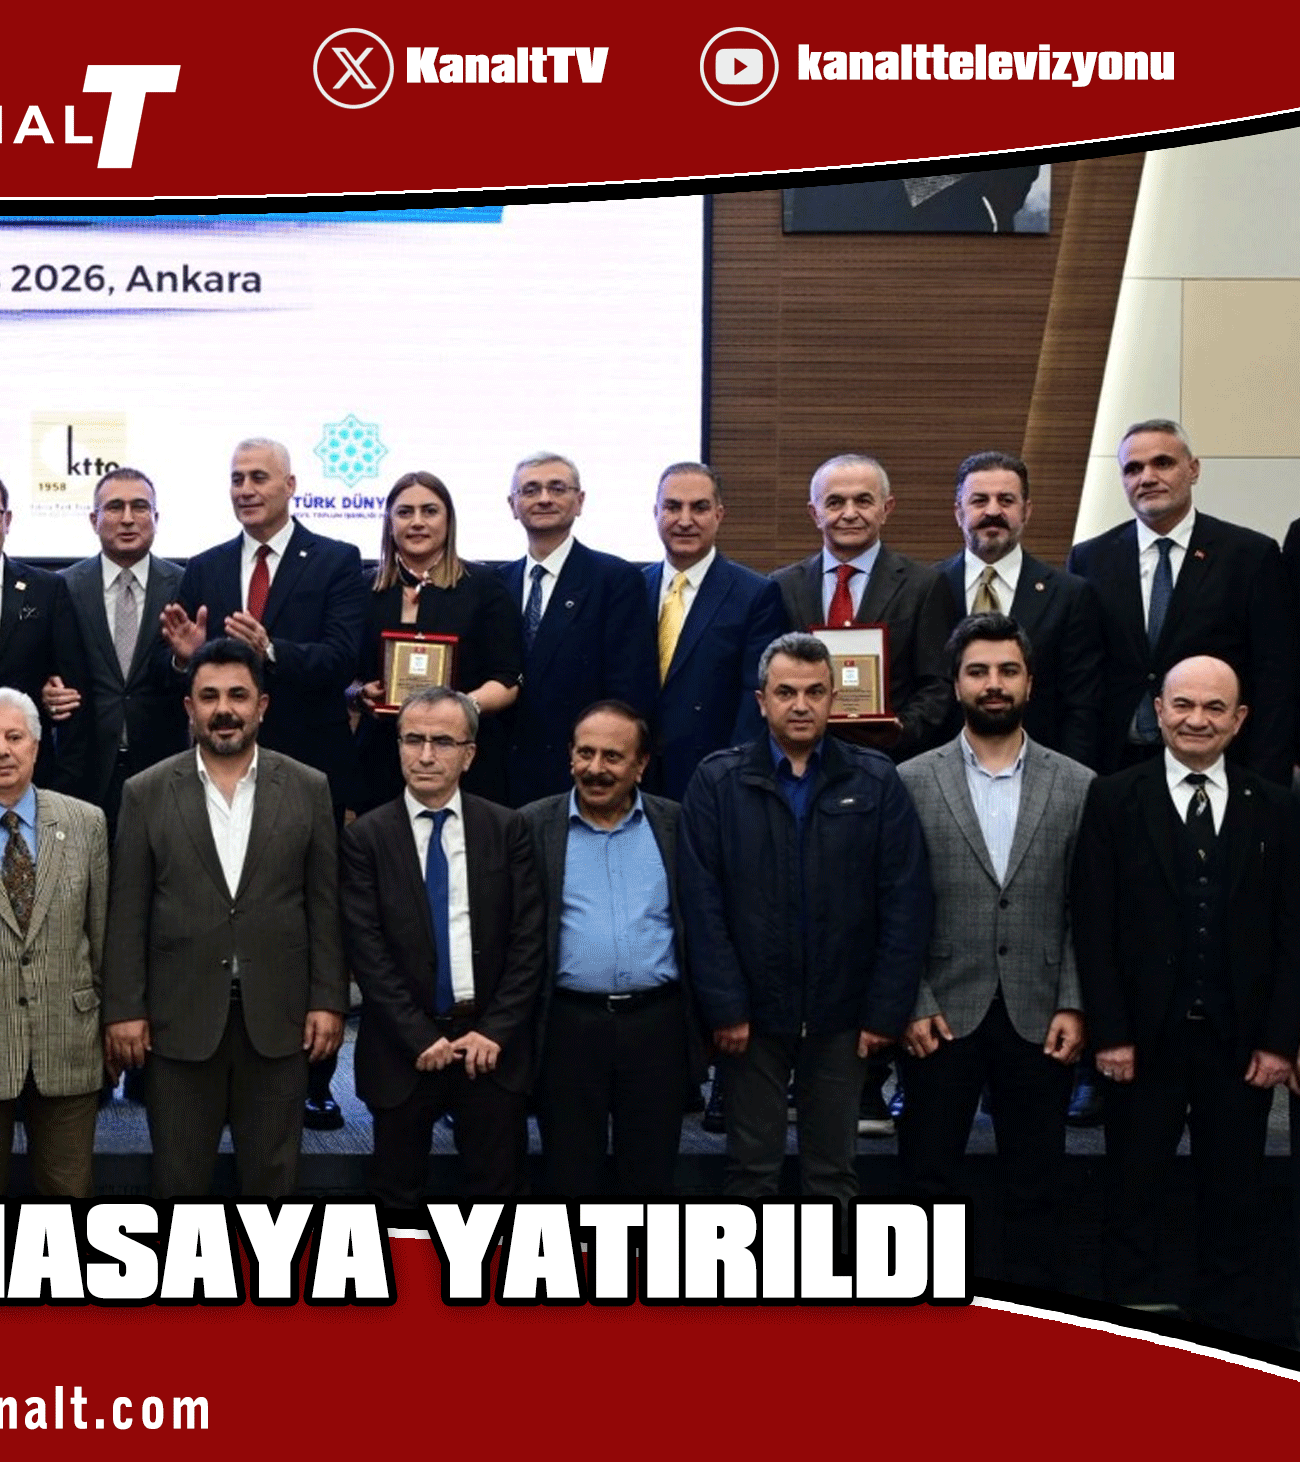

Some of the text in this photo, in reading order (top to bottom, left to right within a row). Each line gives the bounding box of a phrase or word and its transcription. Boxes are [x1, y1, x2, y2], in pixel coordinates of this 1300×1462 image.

[11, 264, 116, 298] 2026,
[126, 264, 262, 292] Ankara
[39, 482, 66, 491] 1958
[294, 492, 387, 509] TÜRK DÜNY
